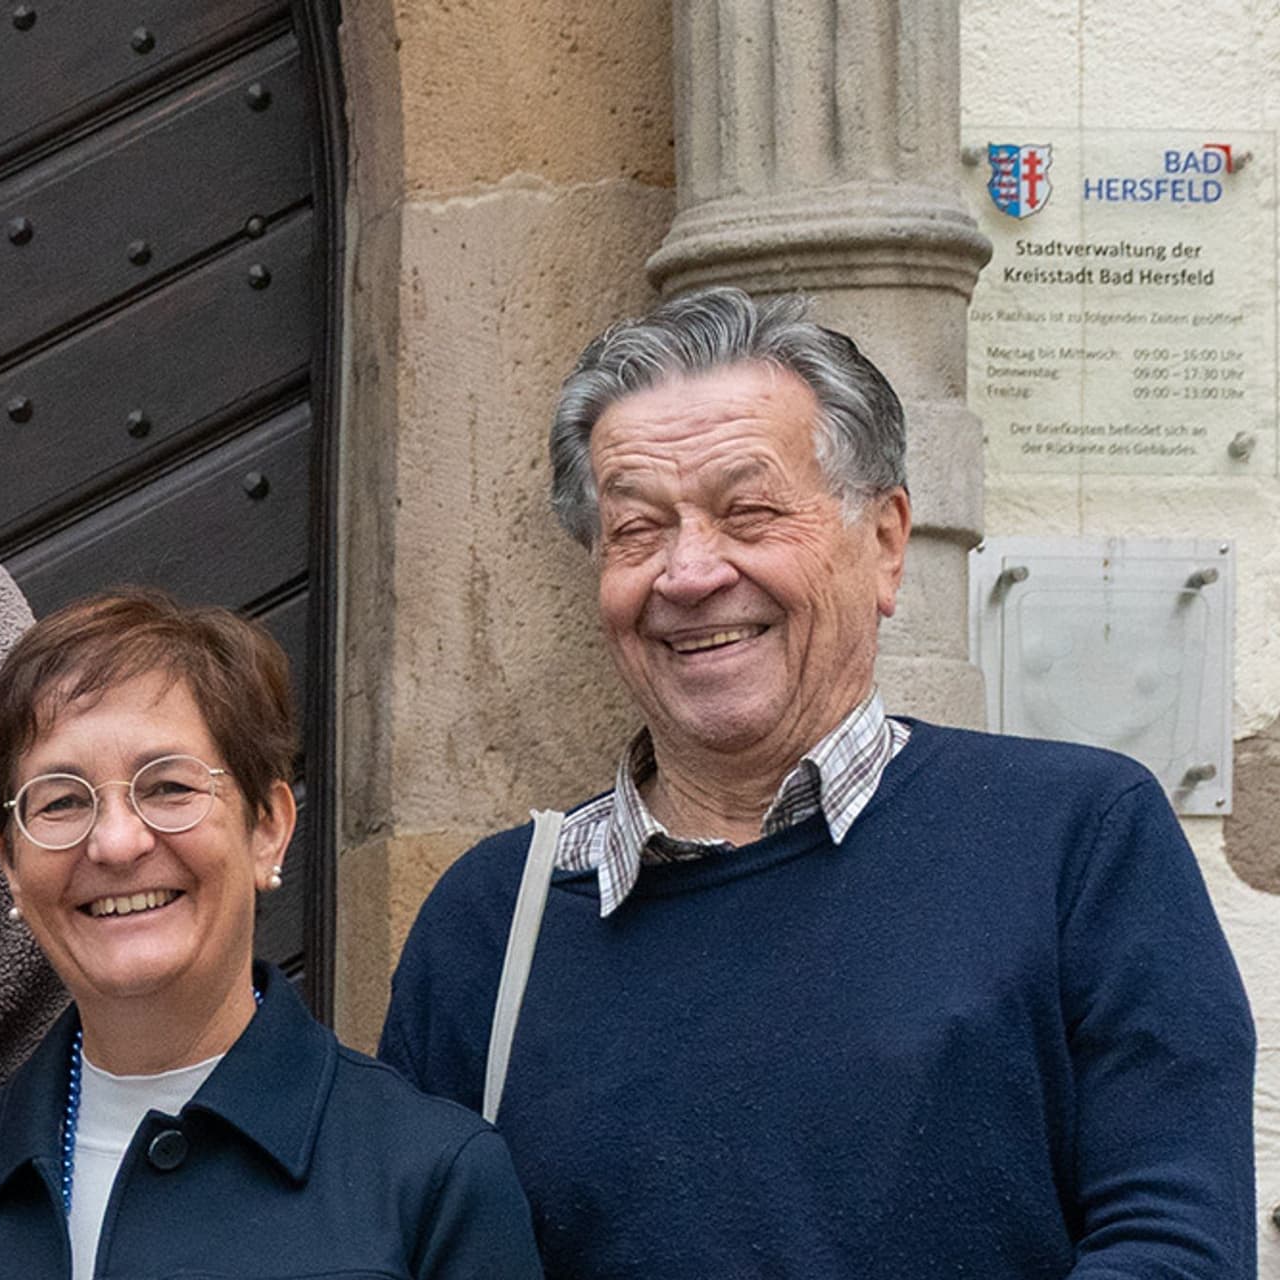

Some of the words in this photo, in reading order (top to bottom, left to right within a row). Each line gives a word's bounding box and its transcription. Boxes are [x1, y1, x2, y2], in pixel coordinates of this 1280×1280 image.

[1165, 151, 1222, 174] BAD
[1084, 179, 1222, 203] HERSFELD
[1016, 240, 1166, 260] Stadtverwaltung
[1172, 241, 1202, 258] der
[1004, 267, 1094, 284] Kreisstadt
[1099, 268, 1134, 284] Bad
[1139, 268, 1214, 285] Hersfeld
[1220, 350, 1245, 361] Uhr
[1220, 369, 1245, 380] Uhr
[1220, 387, 1245, 399] Uhr
[1010, 423, 1033, 436] Der
